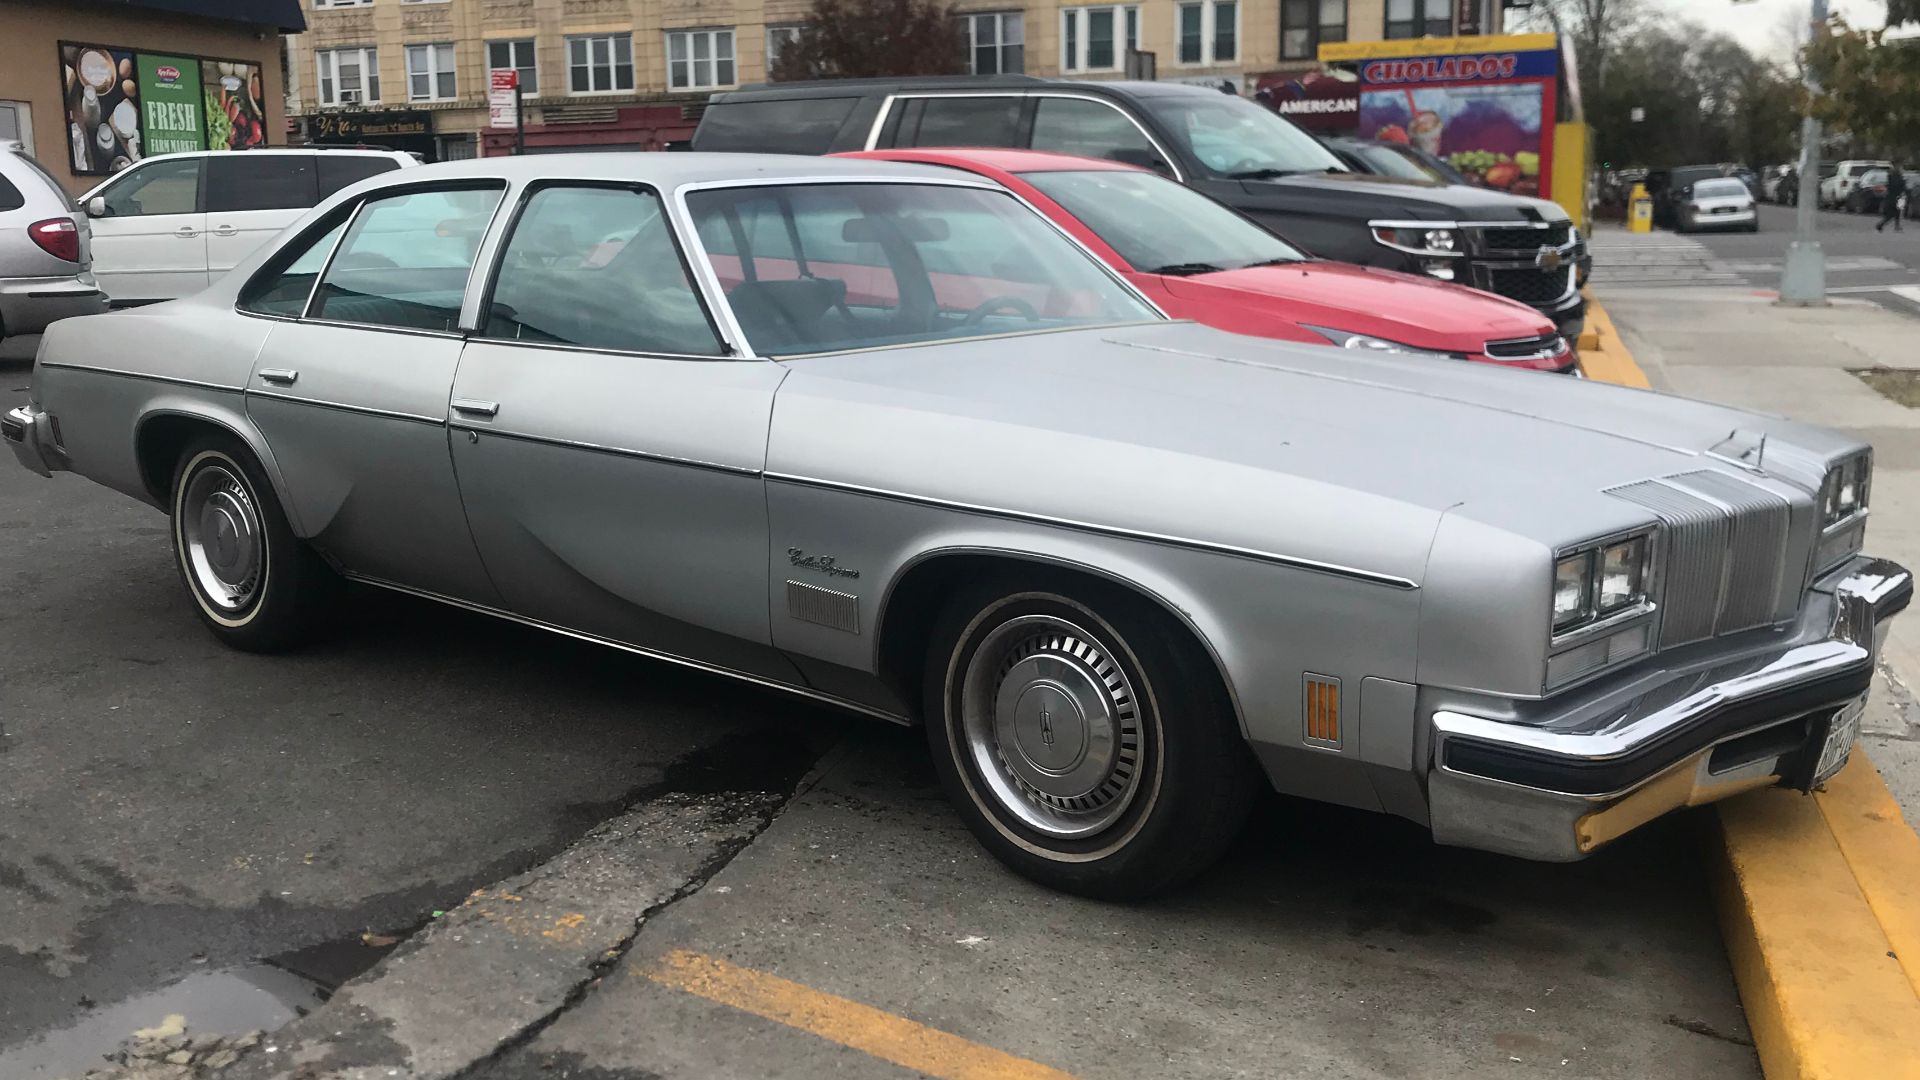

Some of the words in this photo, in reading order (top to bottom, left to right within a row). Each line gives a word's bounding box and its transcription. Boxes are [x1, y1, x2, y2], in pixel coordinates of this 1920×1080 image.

[1364, 54, 1517, 84] CHOLADOS
[146, 101, 197, 132] FRESH
[1279, 98, 1357, 114] AMERICAN
[150, 138, 170, 153] FARM
